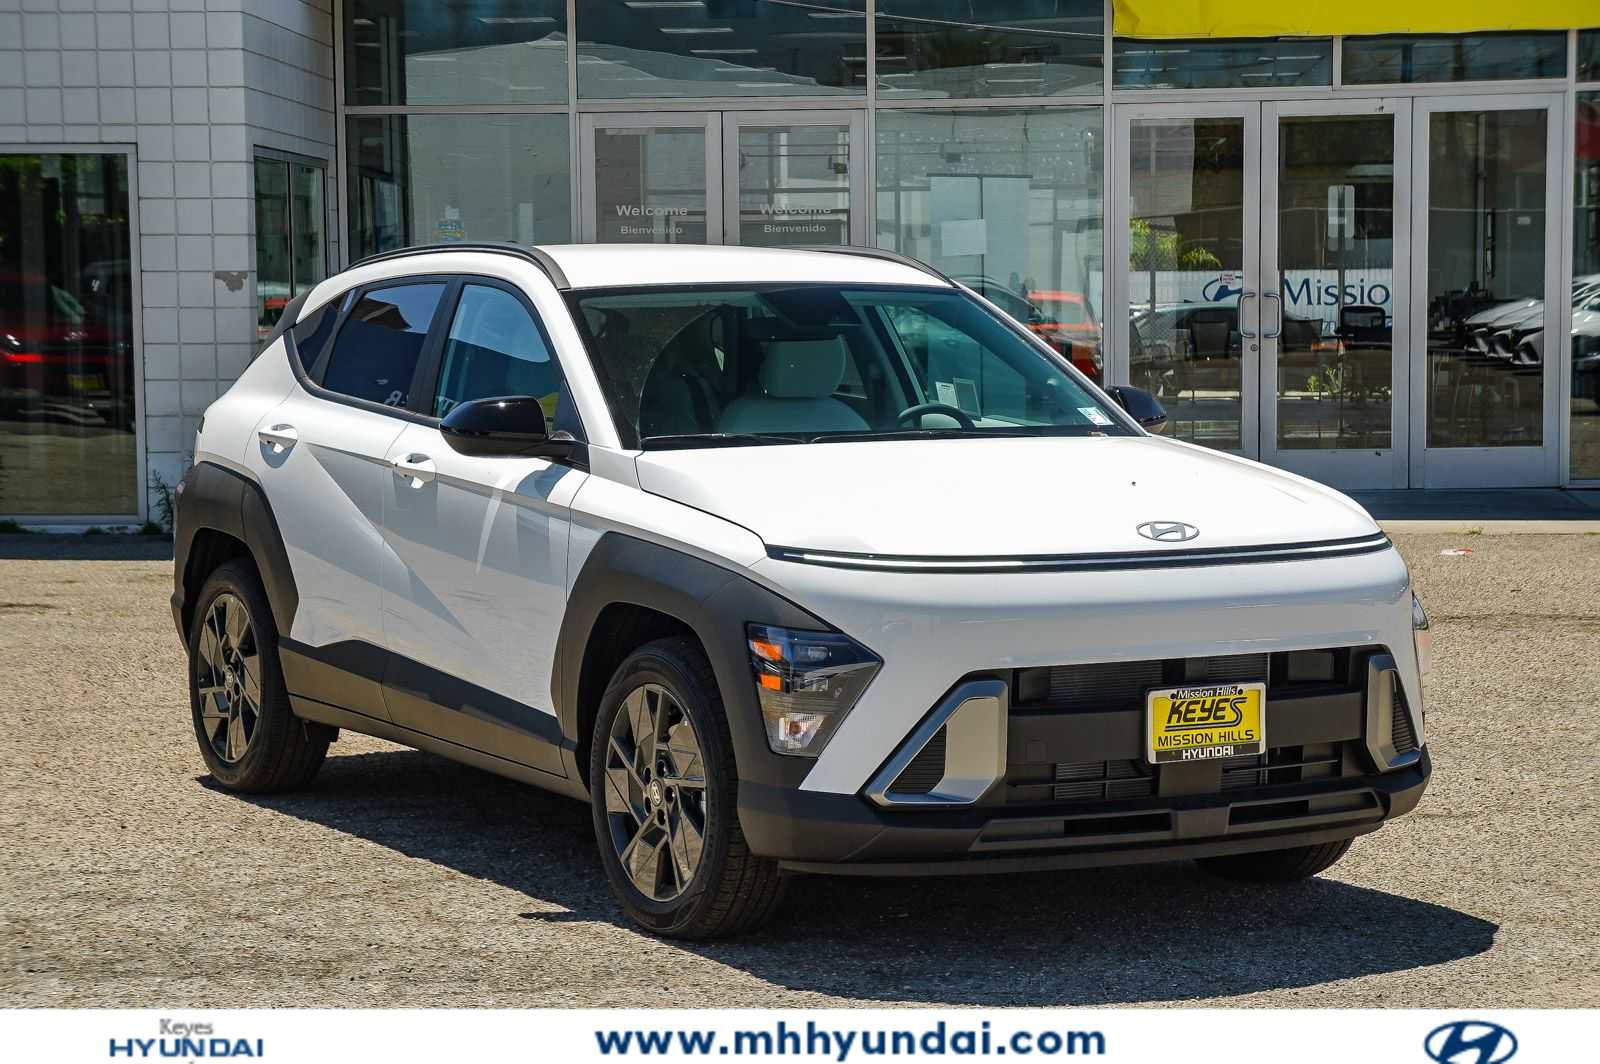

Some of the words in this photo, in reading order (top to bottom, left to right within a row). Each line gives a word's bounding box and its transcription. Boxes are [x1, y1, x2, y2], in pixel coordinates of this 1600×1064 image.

[615, 204, 688, 217] Welcome
[759, 203, 832, 215] Welcome
[620, 225, 684, 235] Bienvenido
[763, 223, 827, 234] Bienvenido
[1177, 688, 1213, 700] Mission
[1215, 686, 1236, 697] Hills
[1164, 697, 1248, 730] KEYES
[1158, 732, 1214, 747] MISSION
[1218, 729, 1255, 743] HILLS
[1182, 745, 1234, 760] HYUNDAI
